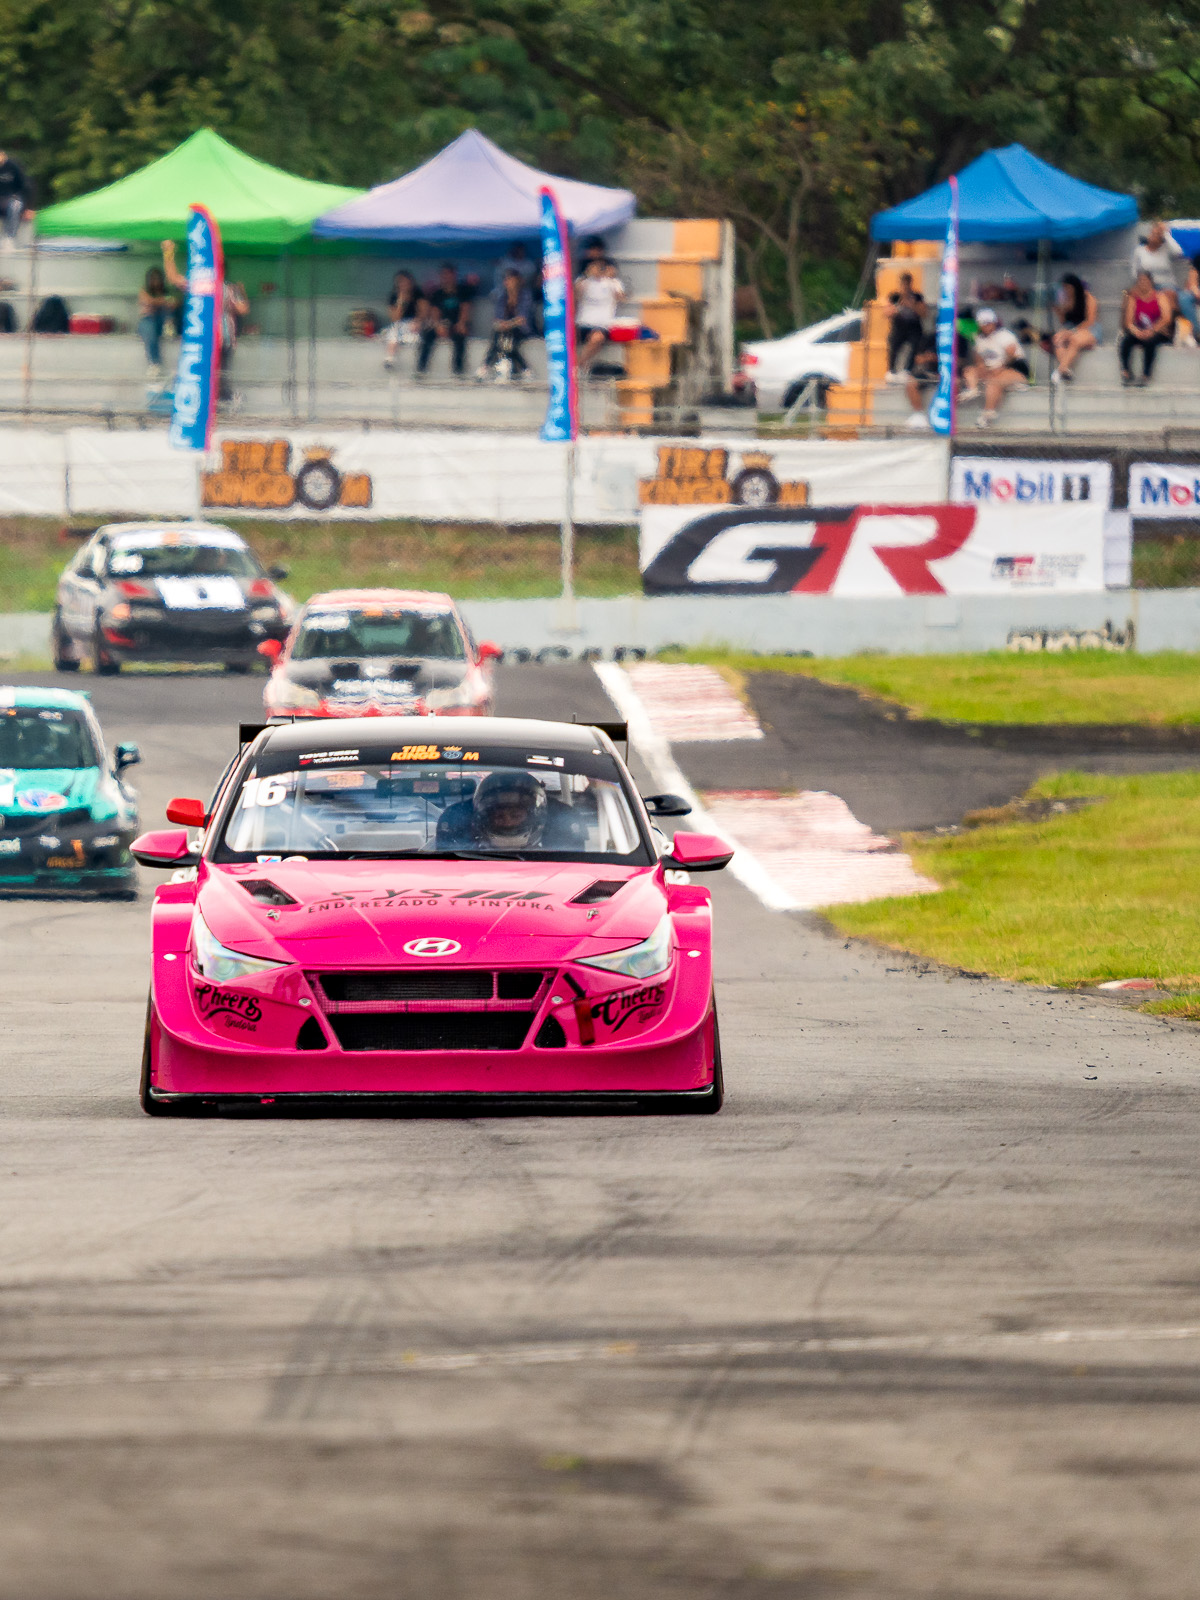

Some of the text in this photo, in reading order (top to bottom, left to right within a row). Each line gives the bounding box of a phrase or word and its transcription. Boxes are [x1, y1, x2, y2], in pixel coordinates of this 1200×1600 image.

[964, 470, 1054, 502] Mobil
[642, 504, 978, 597] GR
[402, 744, 439, 753] TIRE
[242, 776, 288, 809] 16
[308, 899, 439, 914] ENDEREZADO
[467, 899, 555, 912] PINTURA
